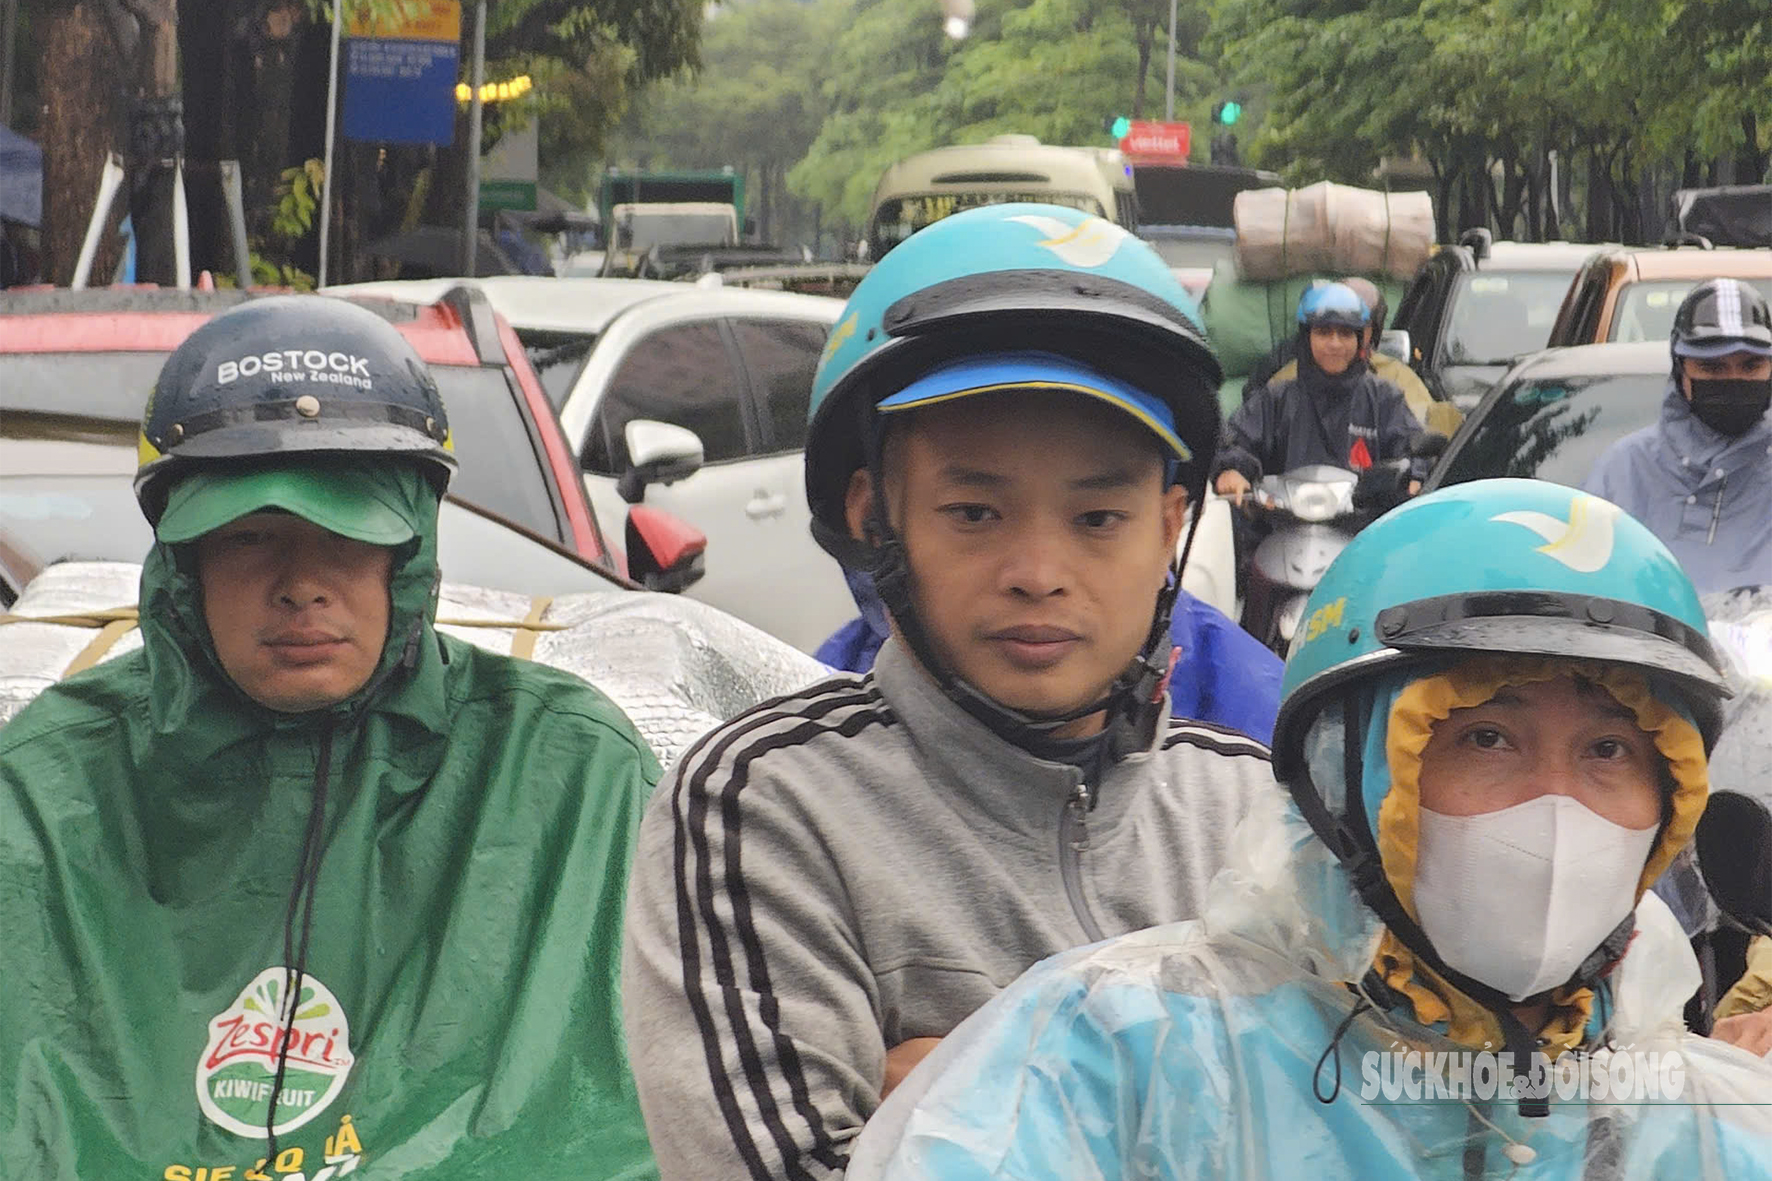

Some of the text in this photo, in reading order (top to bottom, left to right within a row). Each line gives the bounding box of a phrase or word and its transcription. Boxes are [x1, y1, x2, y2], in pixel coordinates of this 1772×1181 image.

[218, 350, 370, 385] BOSTOCK
[271, 370, 373, 389] New Zealand
[205, 1014, 339, 1070] Zespri
